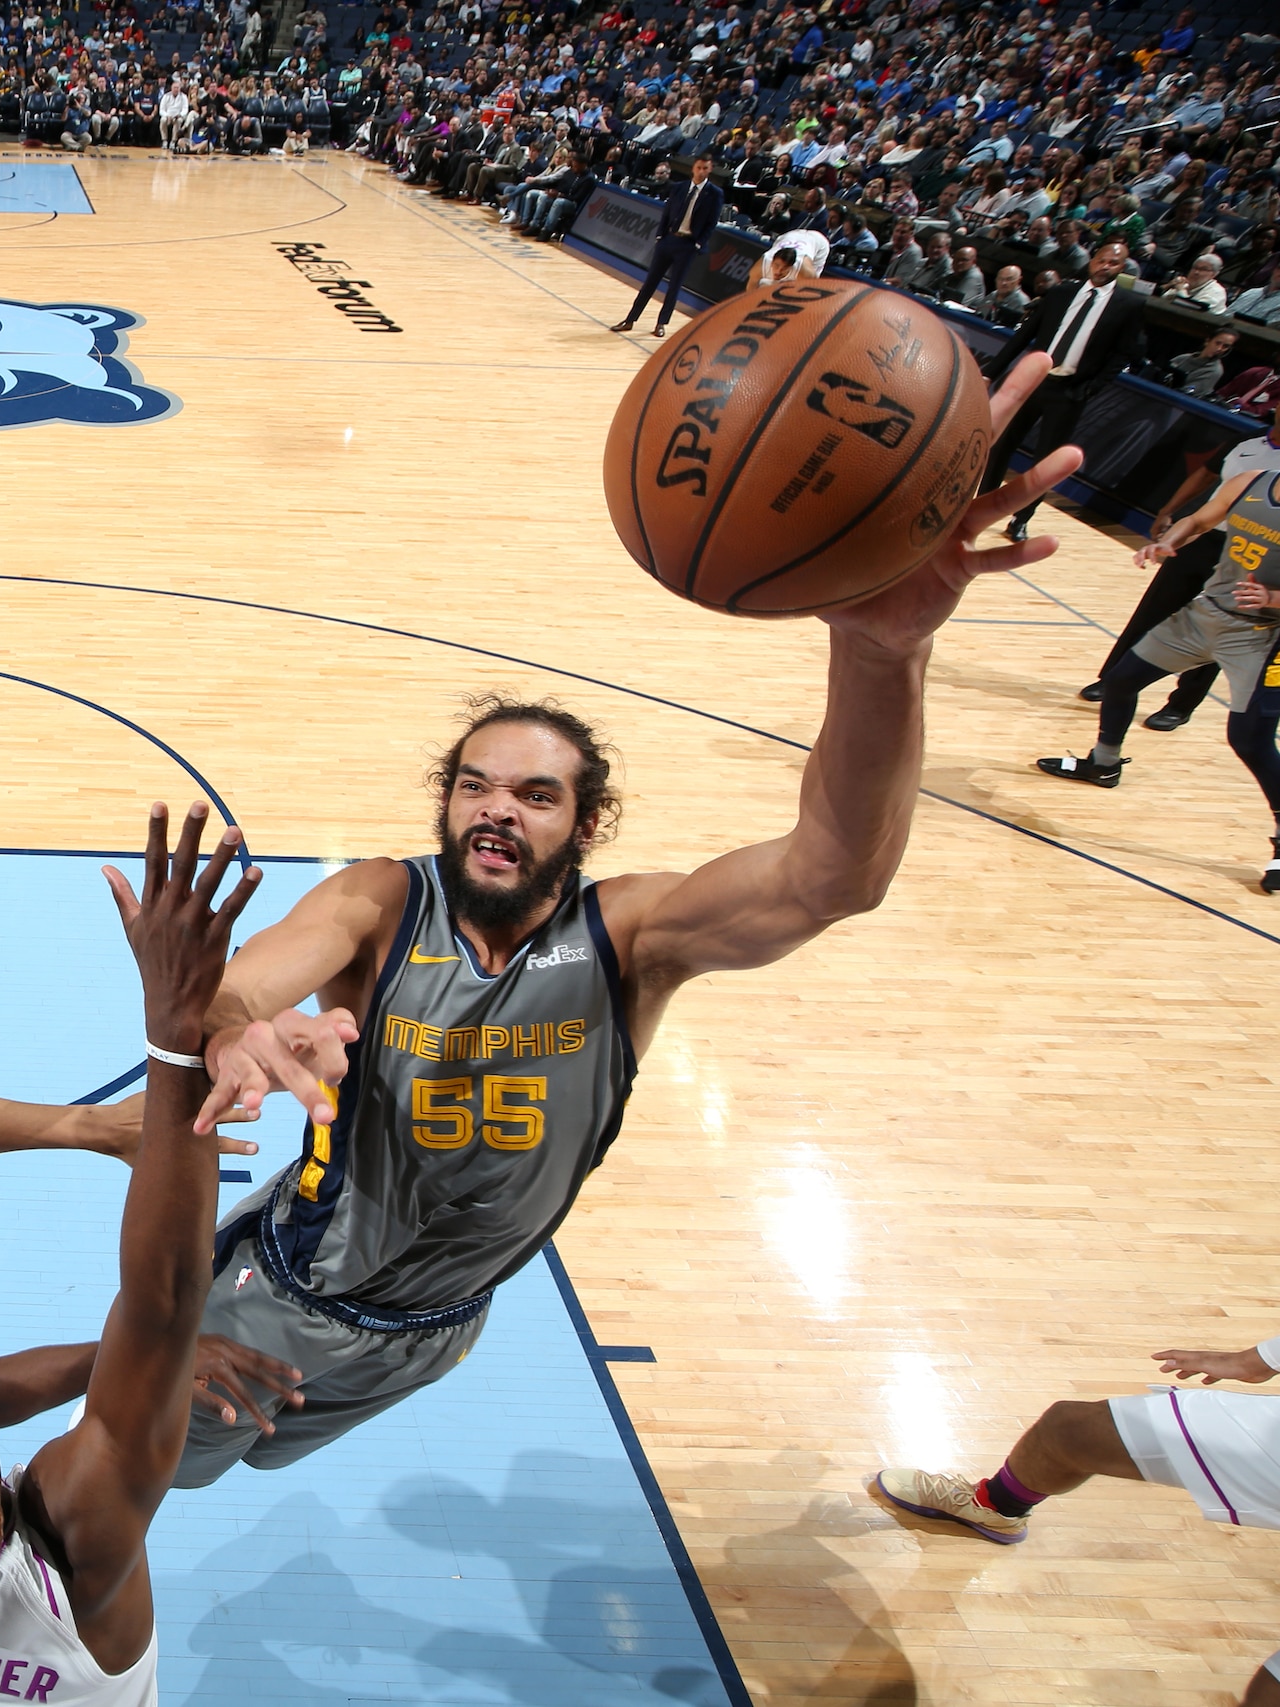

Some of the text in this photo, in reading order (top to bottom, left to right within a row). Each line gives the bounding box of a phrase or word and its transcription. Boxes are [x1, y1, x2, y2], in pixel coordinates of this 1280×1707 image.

[270, 241, 404, 333] FedExForum
[656, 285, 838, 497] SPALDING
[880, 420, 906, 445] NBA
[770, 432, 844, 514] OFFICIAL GAME BALL
[1228, 513, 1280, 545] MEMPHI
[1228, 534, 1269, 571] 25
[526, 944, 589, 970] FedEx
[384, 1014, 585, 1062] MEMPHIS
[411, 1074, 547, 1151] 55
